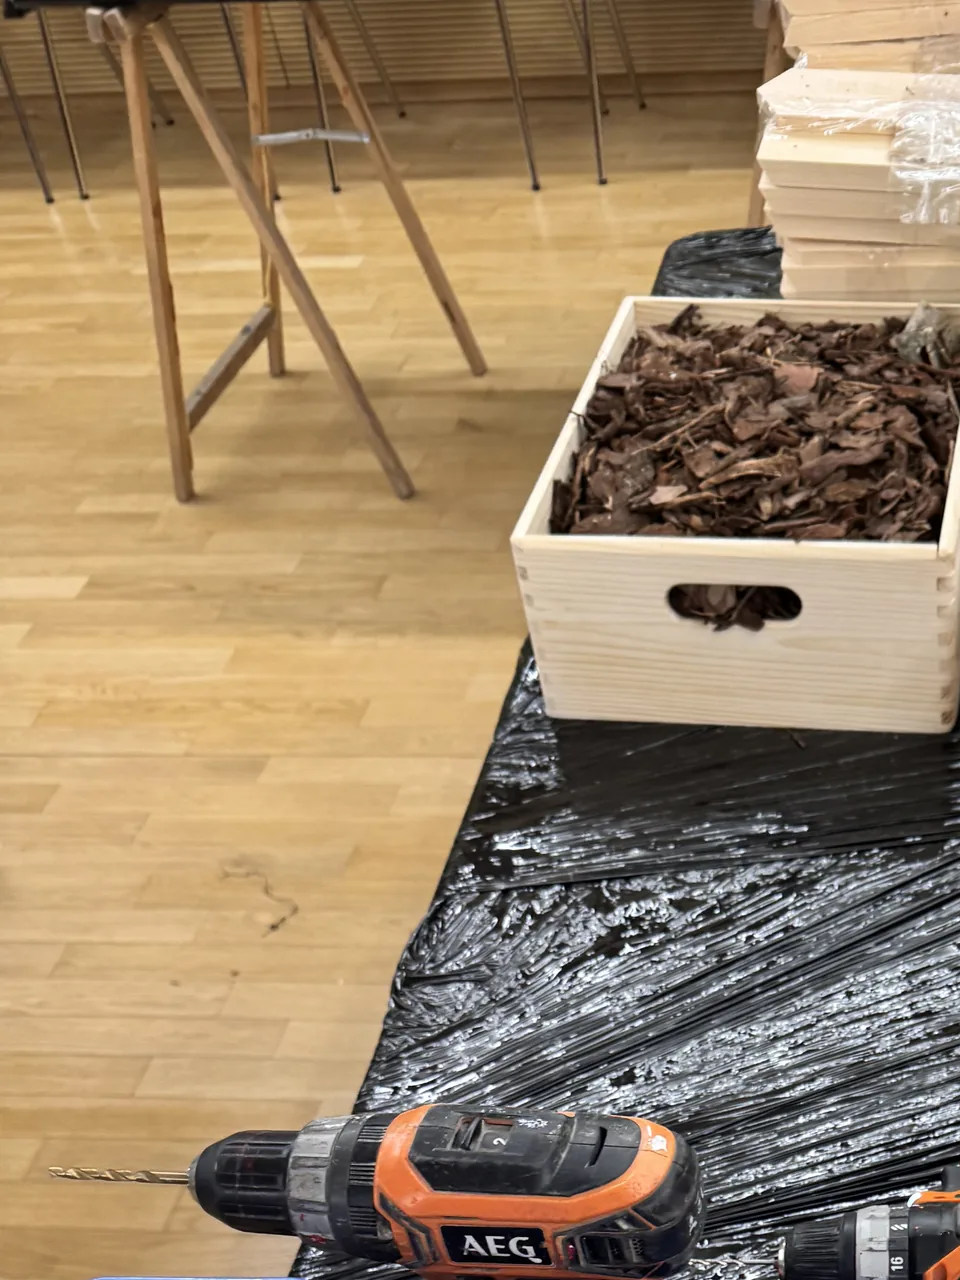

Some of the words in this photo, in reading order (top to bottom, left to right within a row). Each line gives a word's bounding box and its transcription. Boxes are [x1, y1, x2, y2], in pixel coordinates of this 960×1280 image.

[492, 1137, 506, 1146] 2
[462, 1234, 540, 1262] AEG
[890, 1256, 904, 1272] 16
